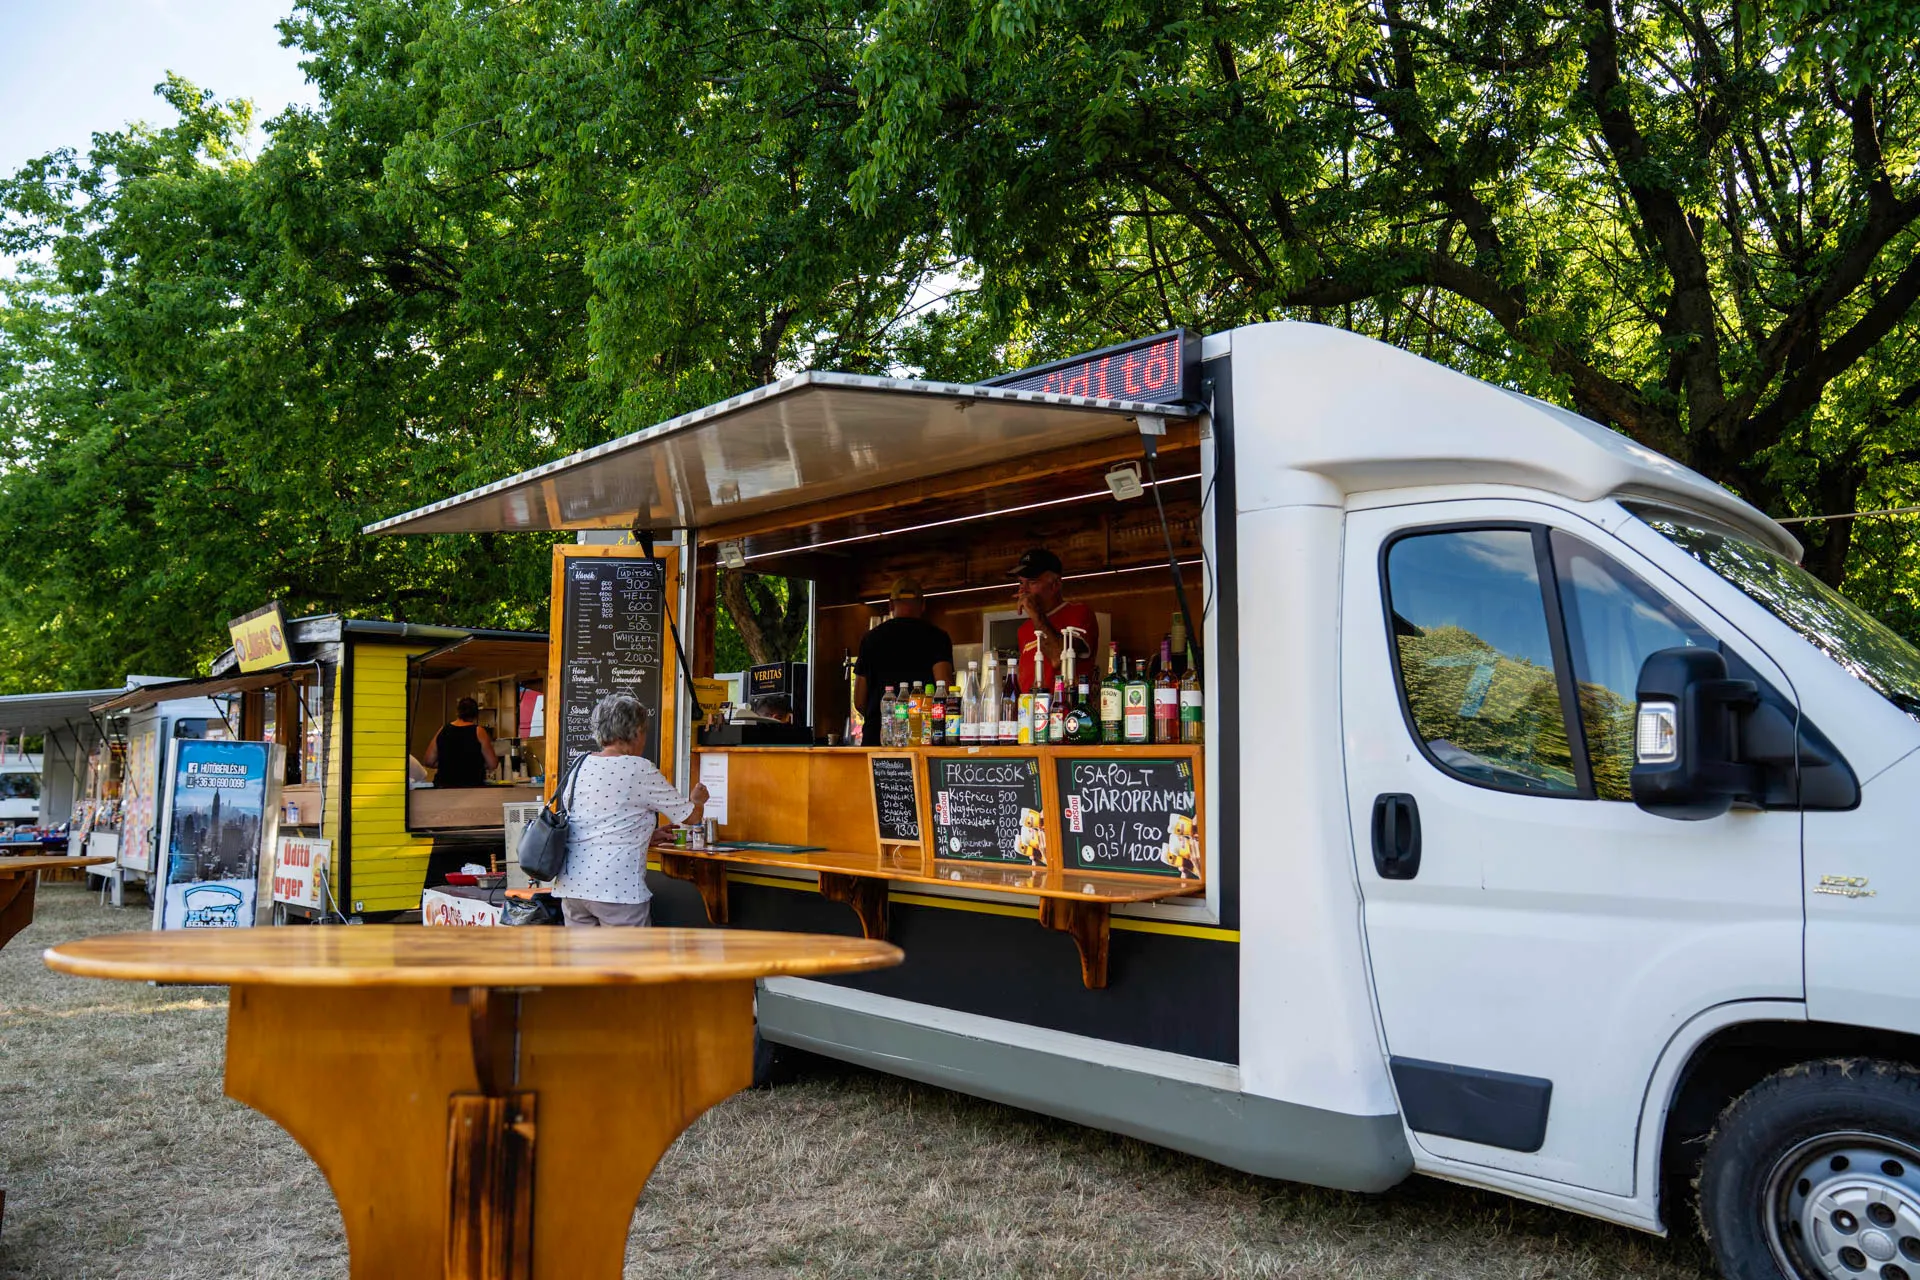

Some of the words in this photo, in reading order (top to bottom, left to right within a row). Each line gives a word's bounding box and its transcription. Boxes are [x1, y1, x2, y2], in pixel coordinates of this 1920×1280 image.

[626, 578, 650, 589] 900
[623, 592, 652, 600] HELL
[628, 601, 652, 611] 600
[754, 669, 782, 681] VERITAS
[946, 763, 1024, 783] FRÖCCSÖK
[1074, 763, 1154, 787] CSAPOLT
[195, 777, 207, 787] +36
[207, 777, 216, 787] 30
[998, 790, 1018, 803] 500
[1081, 787, 1195, 814] STAROPRAMEN
[998, 804, 1018, 816] 900
[1072, 797, 1081, 831] BORSODI
[999, 817, 1018, 828] 600
[894, 824, 918, 837] 1300
[951, 826, 968, 837] Vice
[995, 825, 1020, 838] 1000
[1133, 822, 1162, 841] 900
[961, 848, 984, 859] Sport
[1000, 849, 1017, 860] 700
[275, 877, 303, 900] urger
